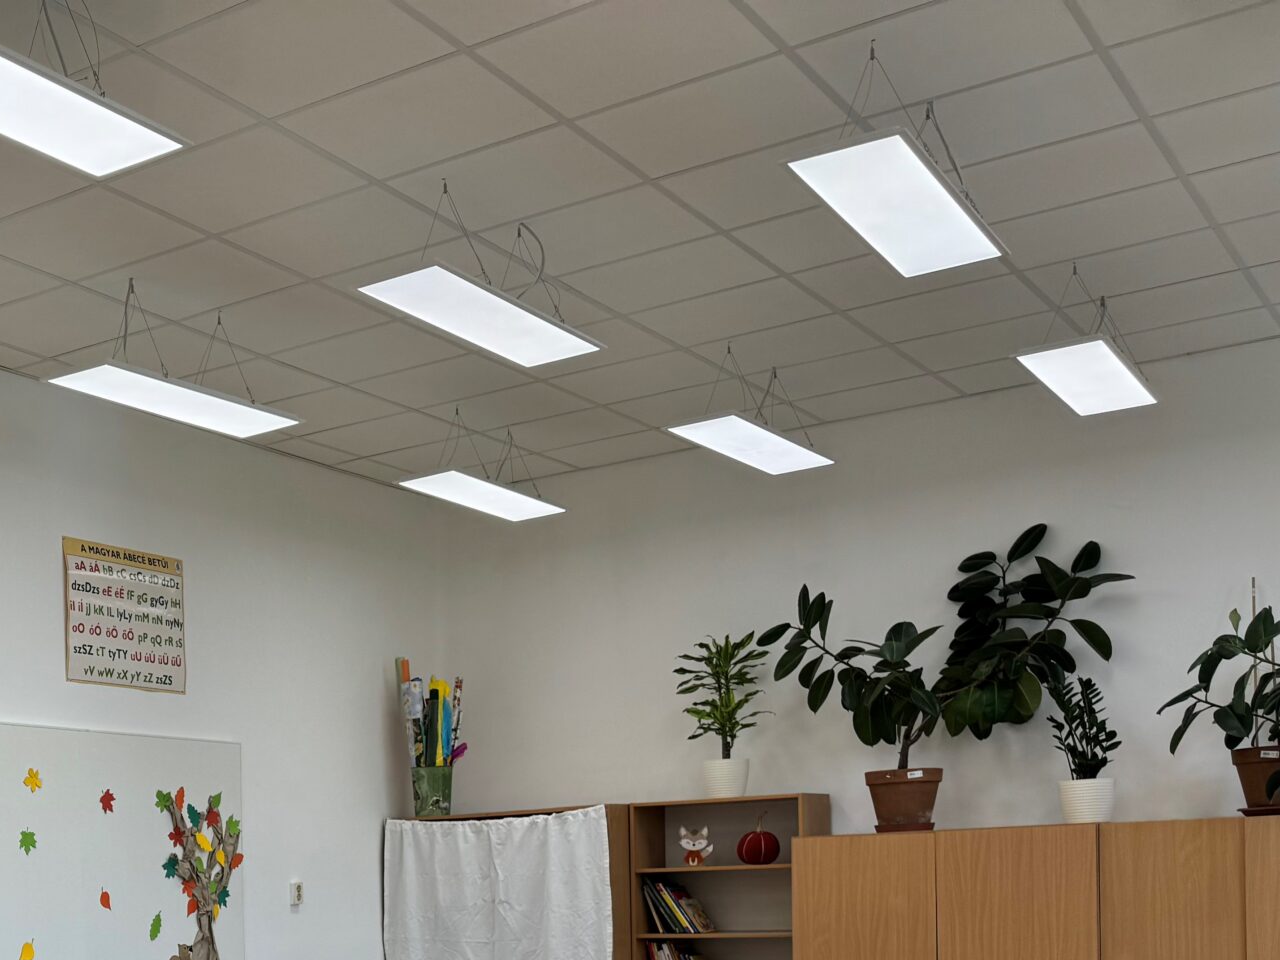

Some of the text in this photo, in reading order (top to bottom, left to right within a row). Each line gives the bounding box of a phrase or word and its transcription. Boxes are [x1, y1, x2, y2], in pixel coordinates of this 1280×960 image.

[81, 544, 86, 553] A
[89, 546, 121, 559] MAGYAR
[75, 561, 86, 571] aA
[103, 565, 113, 575] bB
[116, 569, 127, 579] cC
[129, 571, 146, 583] csCs
[148, 575, 159, 585] dD
[161, 577, 179, 589] dzDz
[72, 580, 100, 594] dzsDzs
[102, 587, 112, 596] eE
[127, 590, 134, 600] fF
[137, 593, 147, 605] gG
[150, 596, 168, 609] gyGy
[171, 599, 180, 608] hH
[94, 604, 104, 616] kK
[117, 608, 132, 623] lyLy
[135, 613, 149, 623] mM
[152, 615, 163, 625] nN
[165, 618, 183, 631] nyNy
[72, 623, 85, 633] oO
[89, 623, 101, 636] óÓ
[138, 633, 148, 645] pP
[151, 635, 162, 647] qQ
[165, 637, 173, 646] rR
[176, 639, 182, 648] sS
[96, 647, 105, 656] tT
[131, 652, 142, 661] uU
[145, 650, 155, 663] úÚ
[84, 666, 95, 676] vV
[98, 668, 114, 678] wW
[117, 670, 128, 680] xX
[131, 672, 141, 683] yY
[144, 673, 153, 683] zZ
